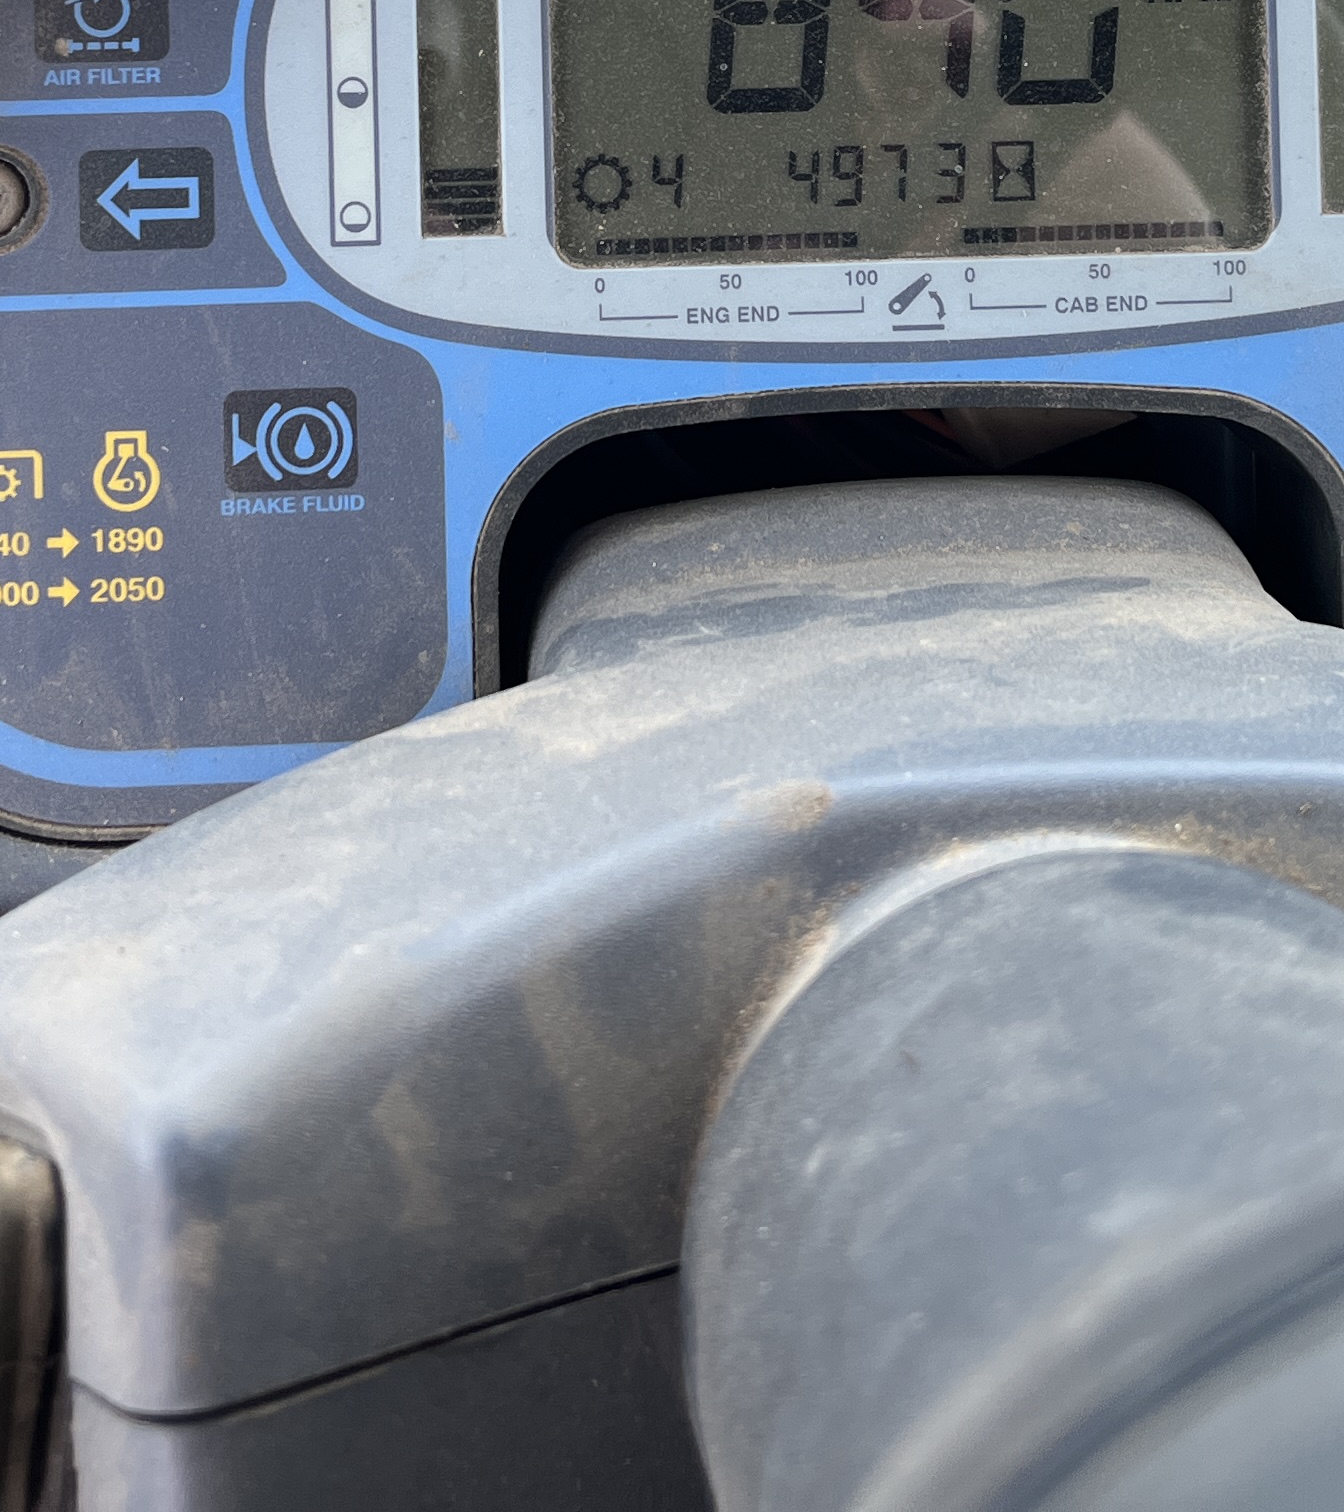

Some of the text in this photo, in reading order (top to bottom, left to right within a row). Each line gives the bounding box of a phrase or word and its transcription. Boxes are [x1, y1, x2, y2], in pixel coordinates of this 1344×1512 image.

[45, 67, 160, 86] AIR FILTER
[652, 142, 966, 209] 4 4973
[594, 269, 878, 294] 0 50 100
[965, 259, 1246, 283] 0 50 100
[686, 304, 780, 325] ENG END
[1055, 294, 1148, 314] CAB END
[220, 495, 365, 516] BRAKE FLUID
[92, 526, 164, 552] 1890
[90, 576, 165, 602] 2050
